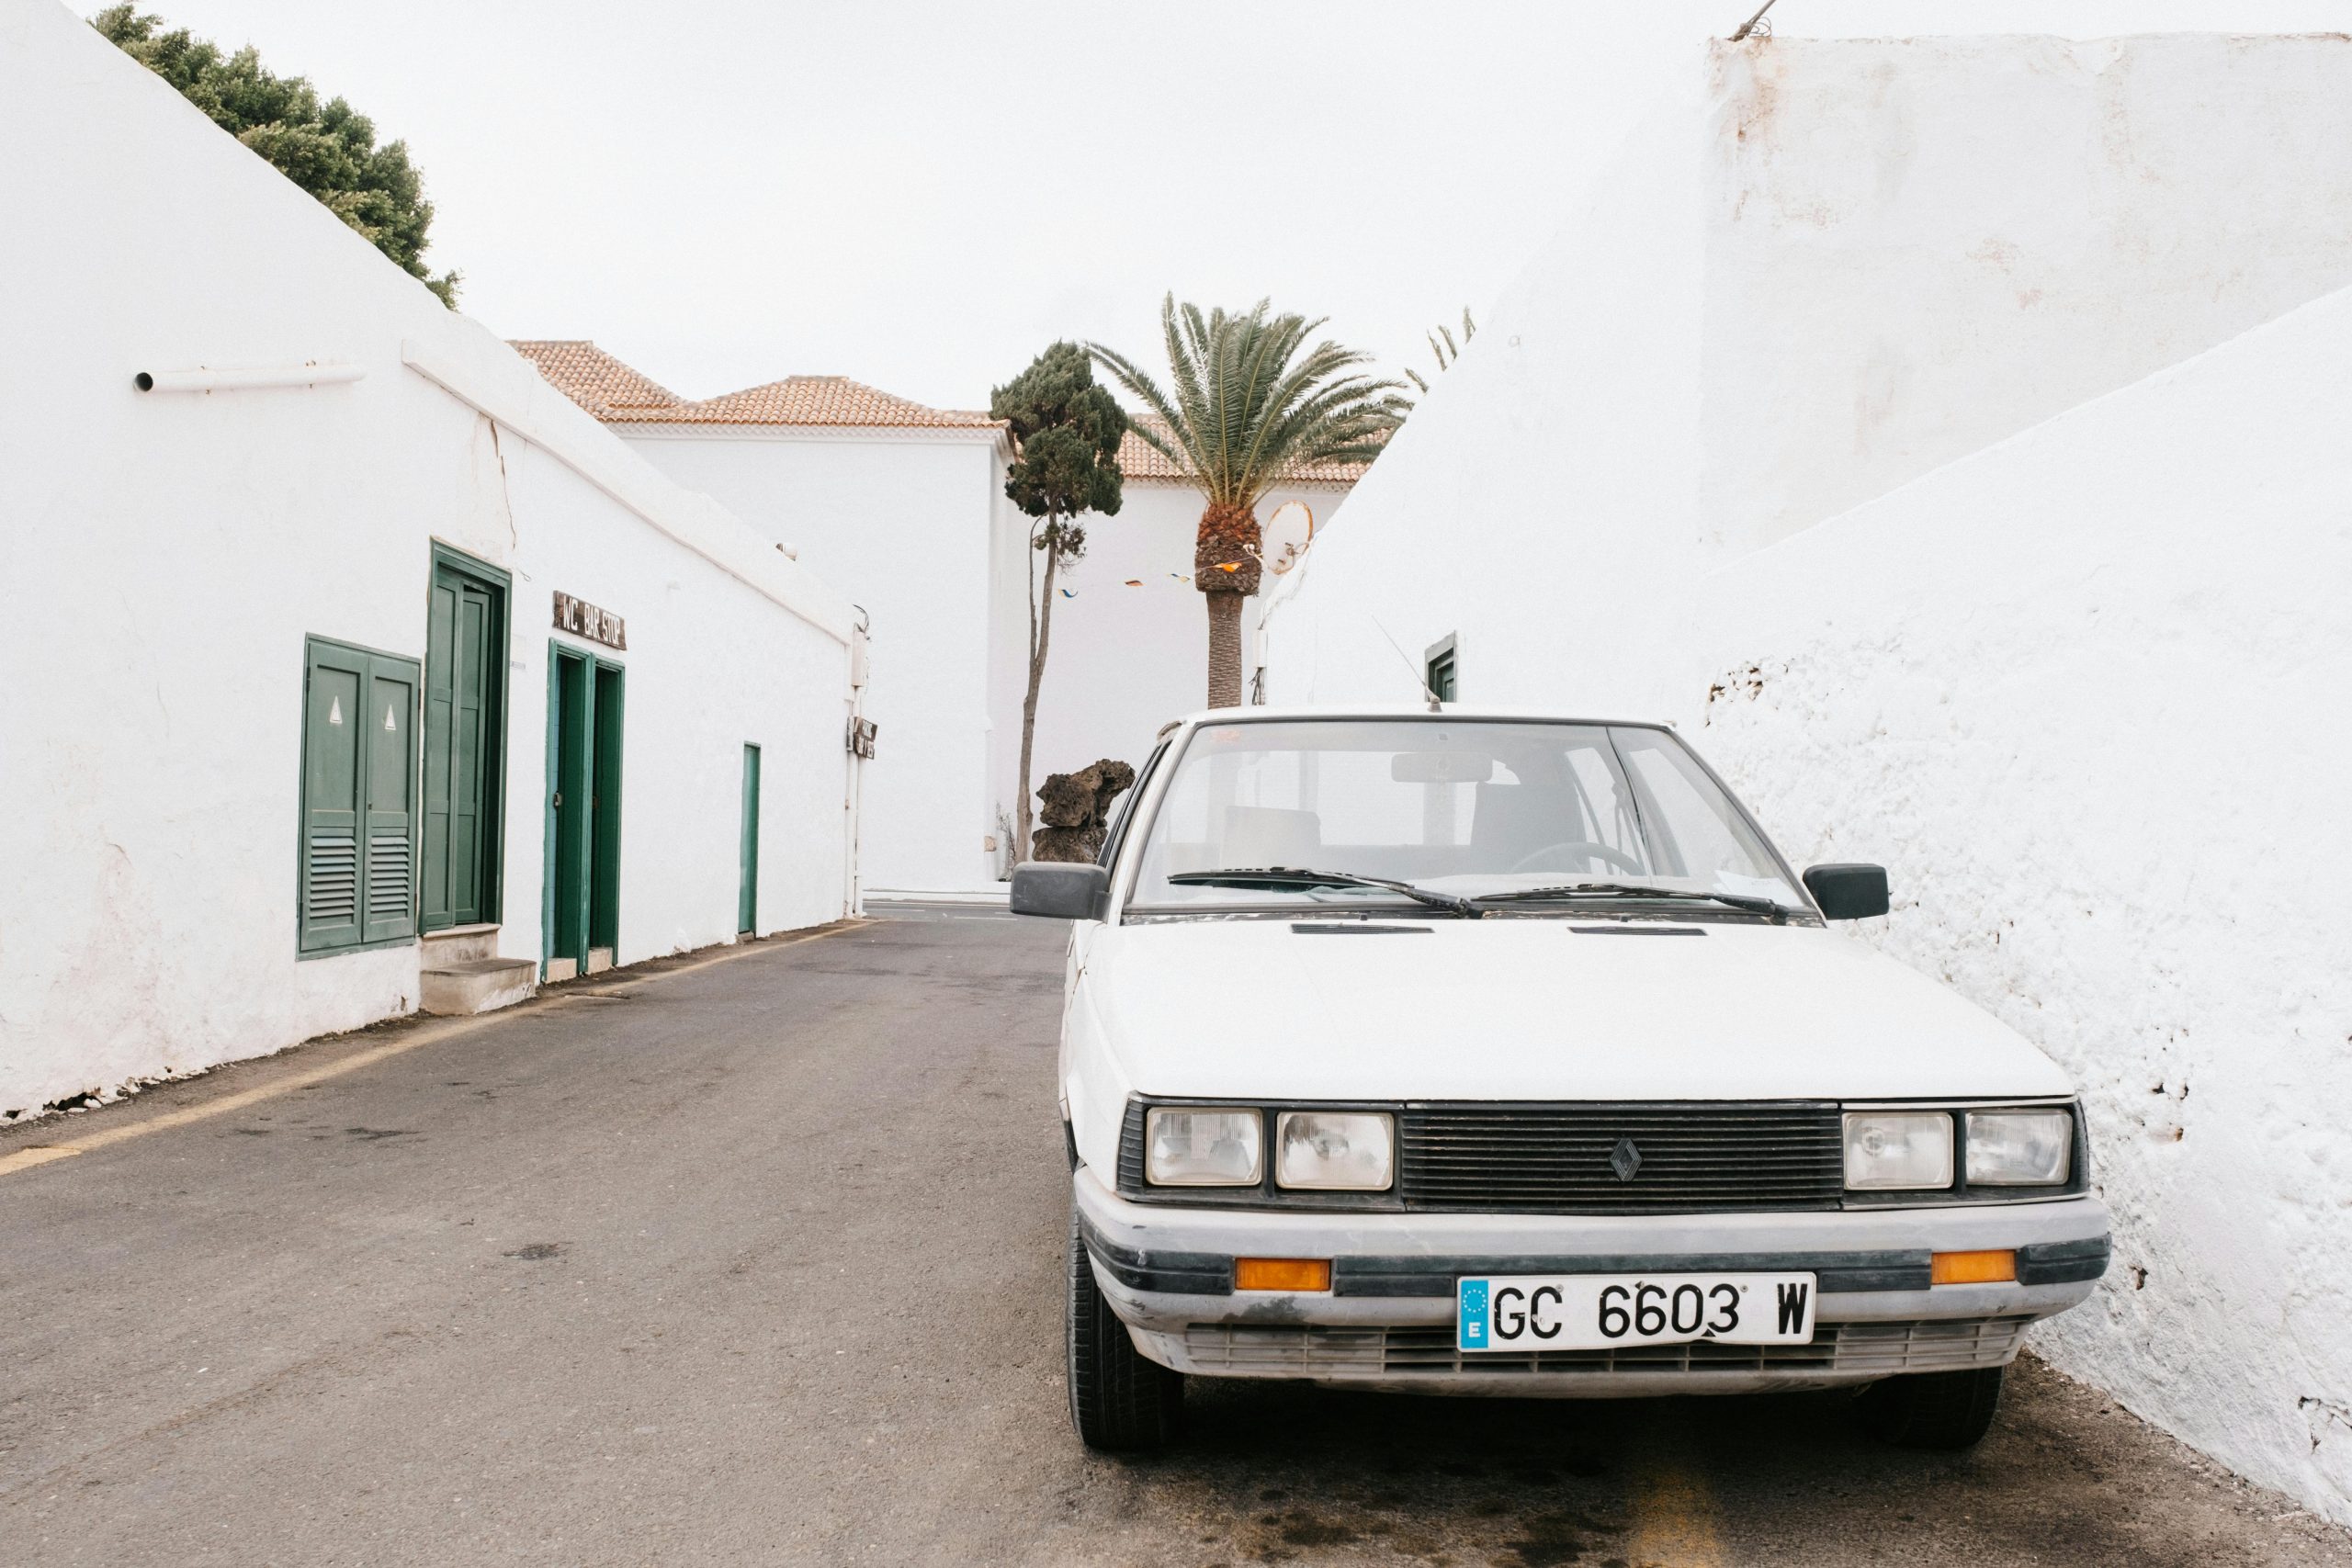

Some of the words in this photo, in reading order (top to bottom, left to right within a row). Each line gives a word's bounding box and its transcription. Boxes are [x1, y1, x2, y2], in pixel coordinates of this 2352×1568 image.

[563, 594, 578, 631] WC
[584, 603, 601, 640] BAR
[602, 611, 621, 646] STOP
[1468, 1322, 1481, 1337] E
[1493, 1286, 1563, 1340] GC
[1599, 1282, 1740, 1338] 6603
[1777, 1282, 1808, 1335] W
